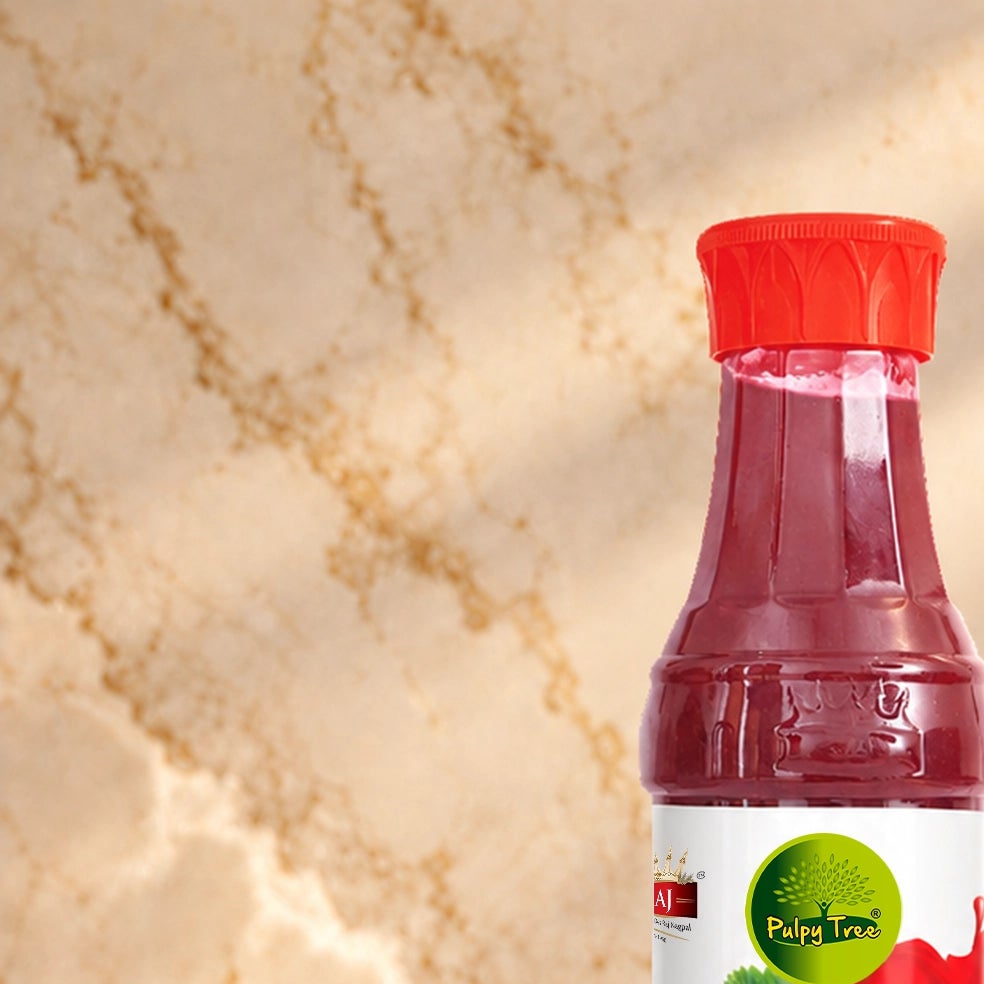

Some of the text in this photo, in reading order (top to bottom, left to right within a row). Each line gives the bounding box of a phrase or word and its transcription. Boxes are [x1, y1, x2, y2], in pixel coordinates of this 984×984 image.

[654, 889, 672, 913] AJ
[766, 916, 823, 946] Pulpy
[827, 915, 881, 939] Tree
